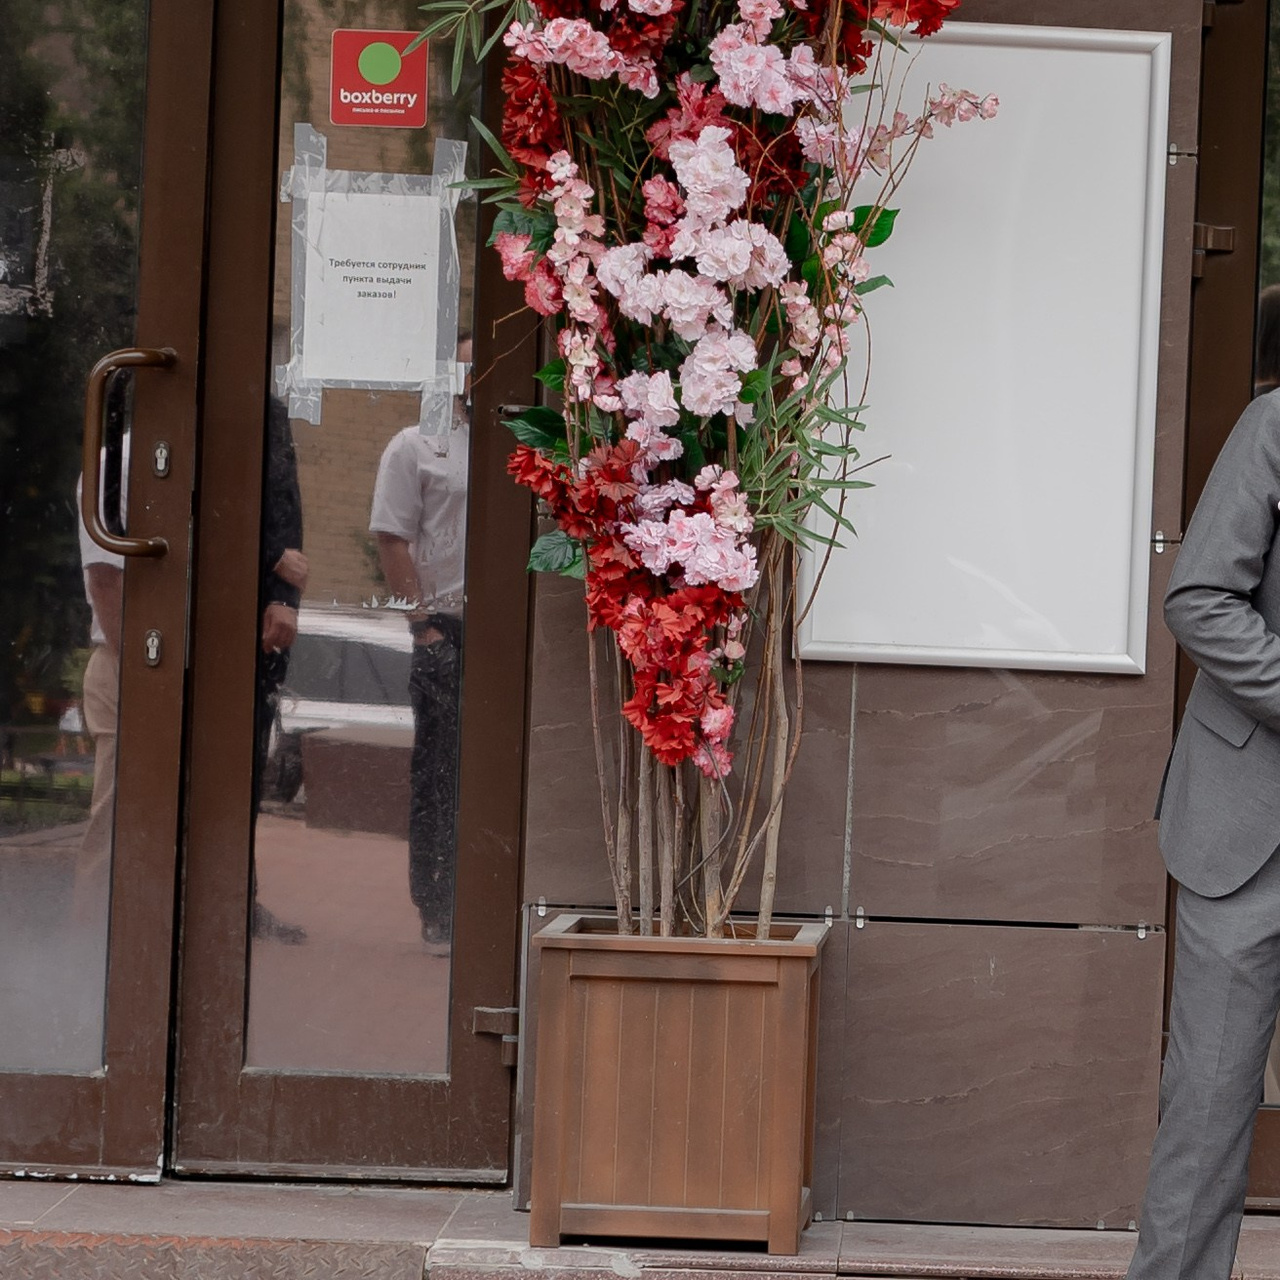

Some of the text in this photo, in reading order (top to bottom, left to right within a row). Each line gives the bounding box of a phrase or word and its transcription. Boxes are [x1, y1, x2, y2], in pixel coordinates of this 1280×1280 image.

[340, 88, 417, 108] boxberry
[328, 258, 427, 270] Требуется сотрудник
[342, 275, 412, 285] пункта выдачи
[357, 290, 397, 299] заказов!
